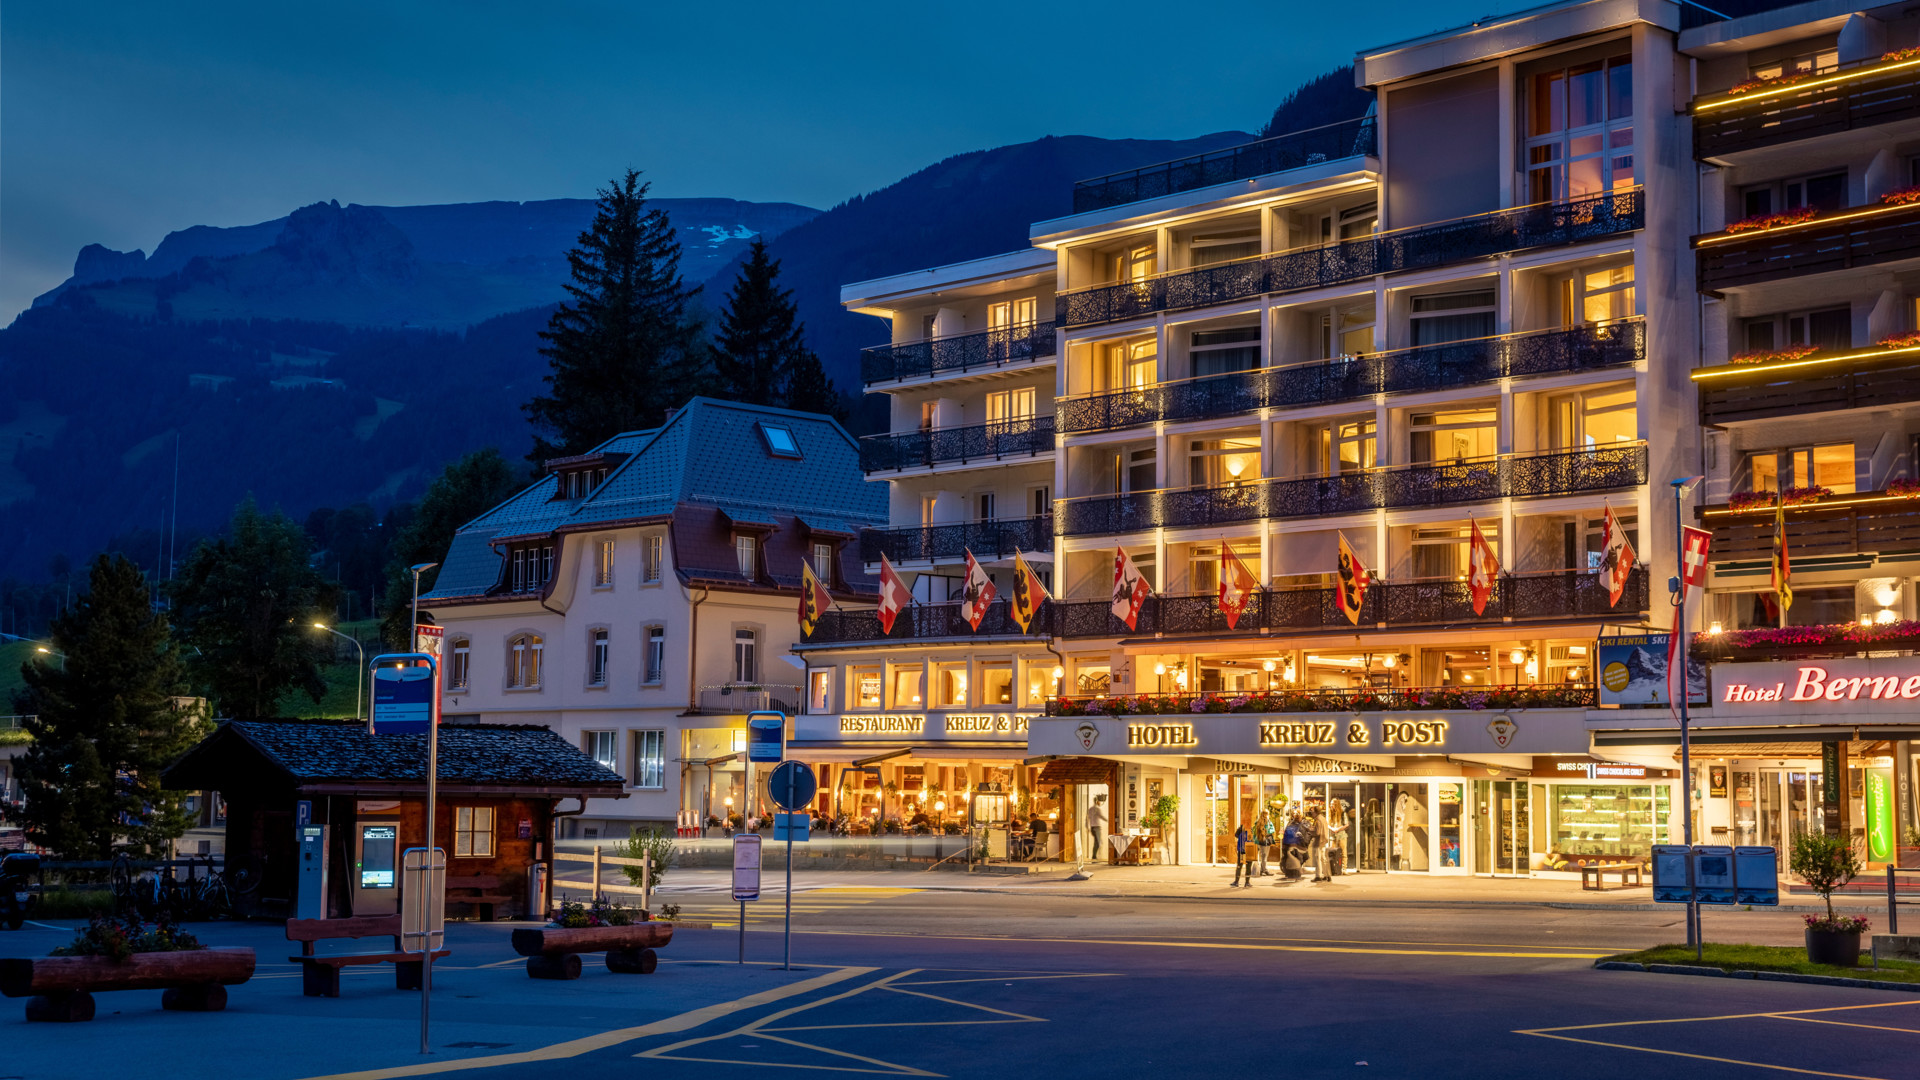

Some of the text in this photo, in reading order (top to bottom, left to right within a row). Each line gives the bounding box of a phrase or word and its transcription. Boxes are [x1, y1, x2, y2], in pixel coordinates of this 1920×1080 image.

[1601, 638, 1616, 647] SKI
[1617, 636, 1648, 646] RENTAL
[1652, 635, 1667, 645] SKI
[1723, 682, 1784, 702] Hotel
[839, 716, 924, 732] RESTAURANT
[945, 716, 991, 731] KREUZ
[996, 716, 1009, 731] &
[1128, 725, 1196, 746] HOTEL
[1259, 722, 1446, 744] KREUZ & POST
[1297, 759, 1343, 773] SNACK
[1392, 768, 1433, 776] TAKE AWAY
[1557, 763, 1577, 771] SWISS
[1900, 773, 1909, 821] HOTEL
